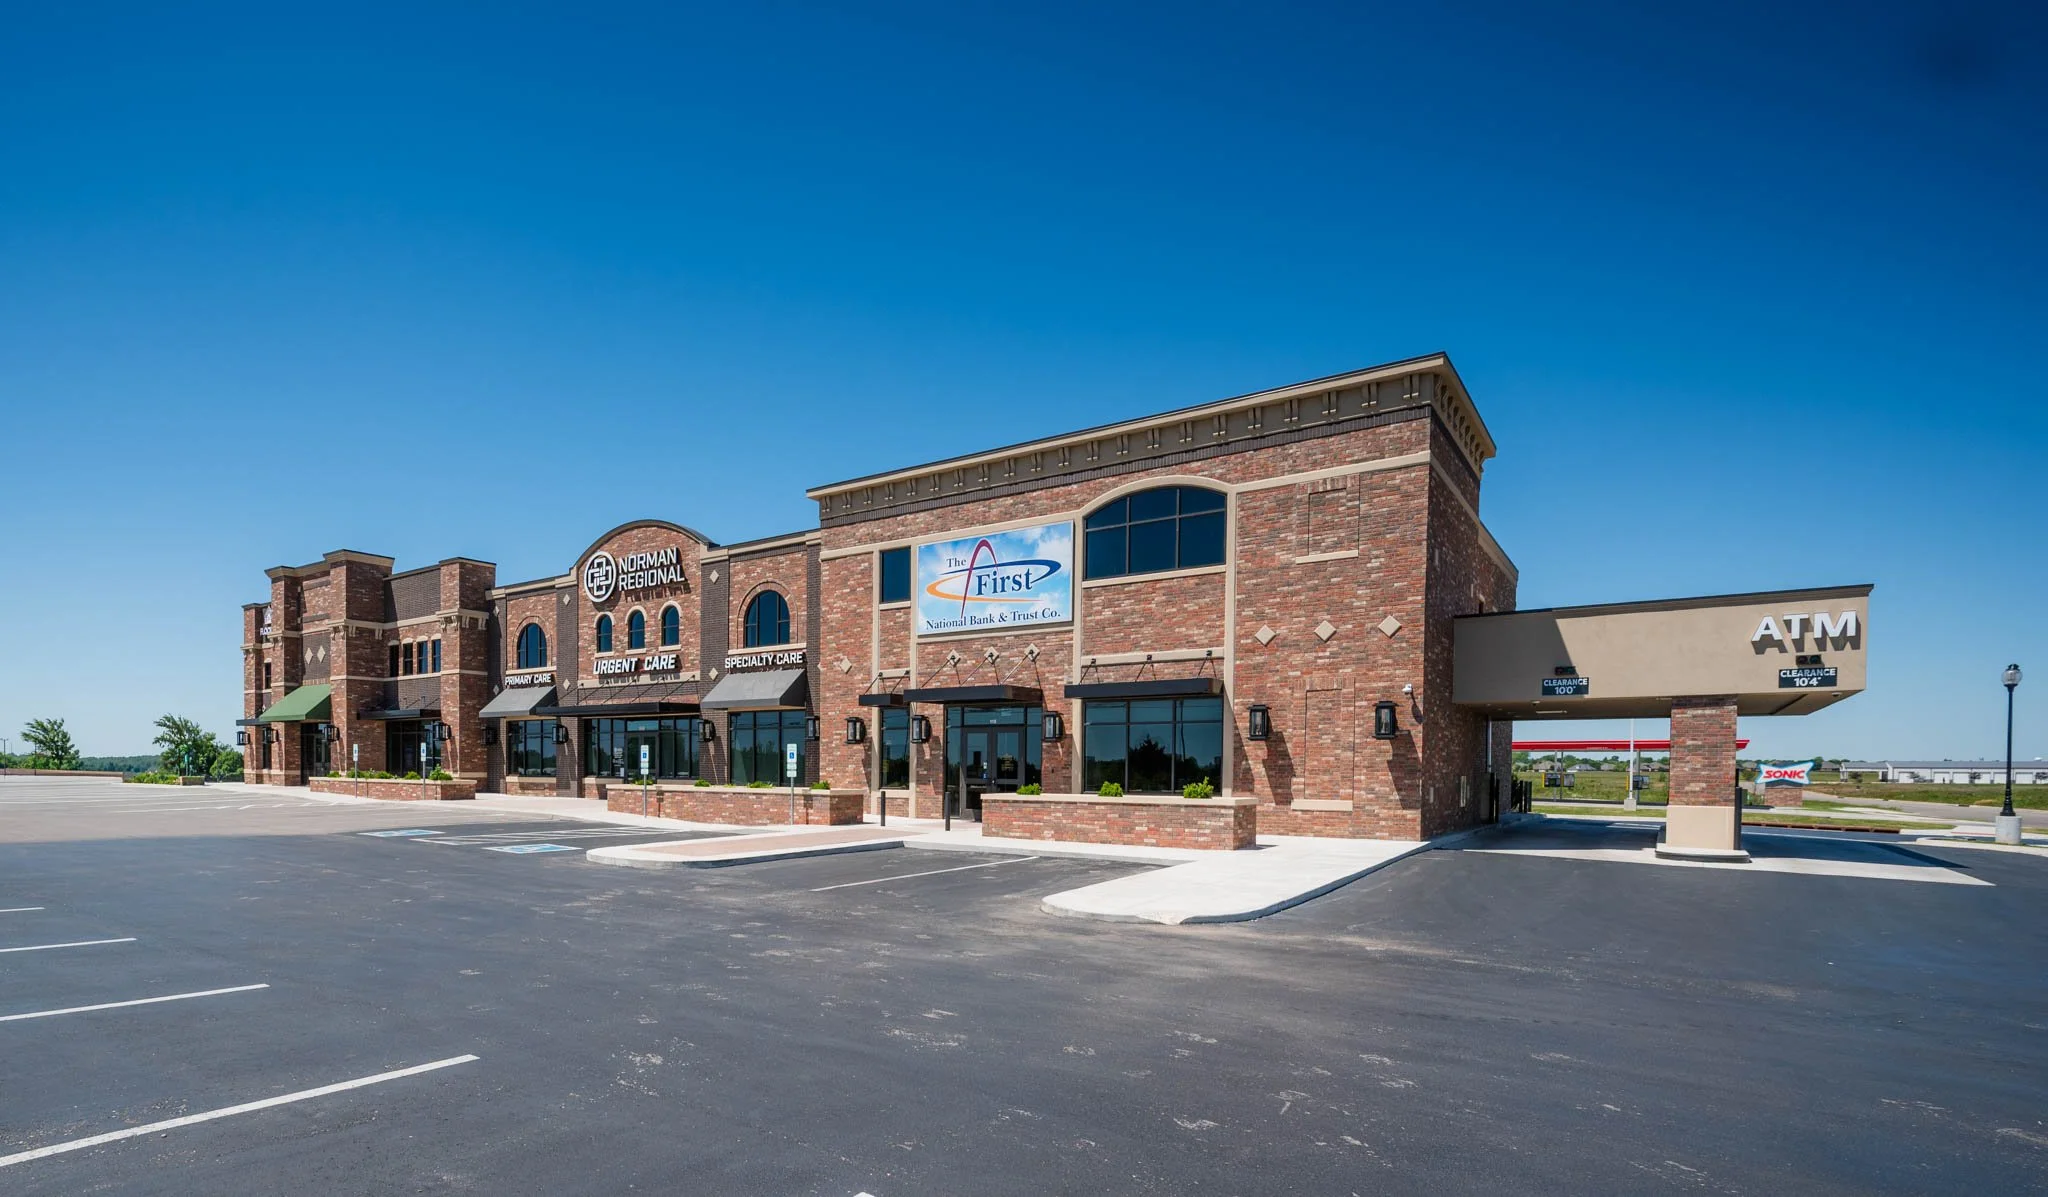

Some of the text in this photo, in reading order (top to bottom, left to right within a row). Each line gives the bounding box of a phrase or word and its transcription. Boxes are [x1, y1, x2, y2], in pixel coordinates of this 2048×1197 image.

[619, 547, 677, 574] NORMAN
[946, 557, 966, 567] The
[619, 564, 685, 591] REGIONAL
[976, 568, 1033, 596] First
[926, 607, 1061, 630] National Bank & Trust Co.
[1751, 610, 1857, 641] ATM
[593, 654, 677, 675] URGENT CARE
[724, 652, 803, 669] SPECIALTY CARE
[505, 673, 551, 685] PRIMARY CARE
[1780, 668, 1836, 678] CLEARANCE
[1763, 770, 1805, 779] SONIC
